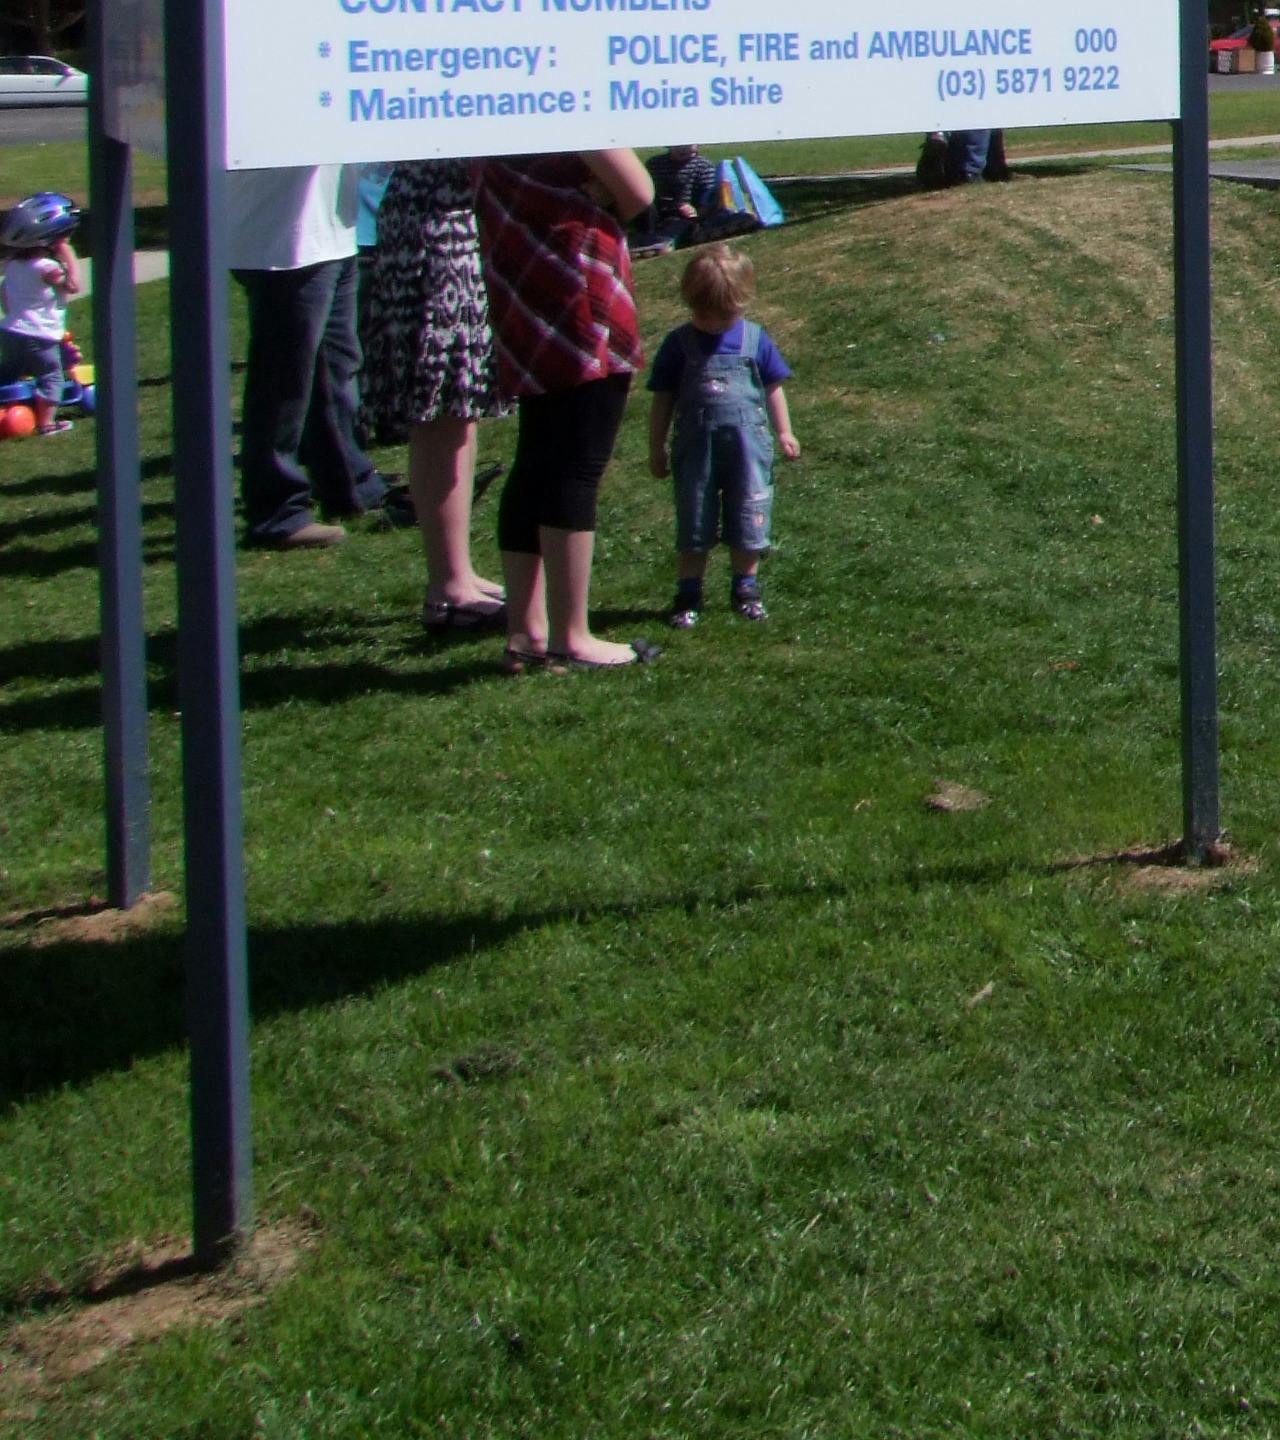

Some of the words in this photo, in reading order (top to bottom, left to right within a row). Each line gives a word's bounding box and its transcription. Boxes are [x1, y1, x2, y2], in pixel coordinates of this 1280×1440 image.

[608, 34, 727, 67] POLICE,
[739, 33, 799, 61] FIRE
[810, 32, 859, 60] and
[867, 29, 1032, 59] AMBULANCE
[1075, 28, 1118, 53] 000
[609, 79, 699, 110] Moira
[711, 76, 783, 106] Shire
[937, 69, 985, 101] (03)
[996, 67, 1053, 94] 5871
[1063, 65, 1119, 91] 9222
